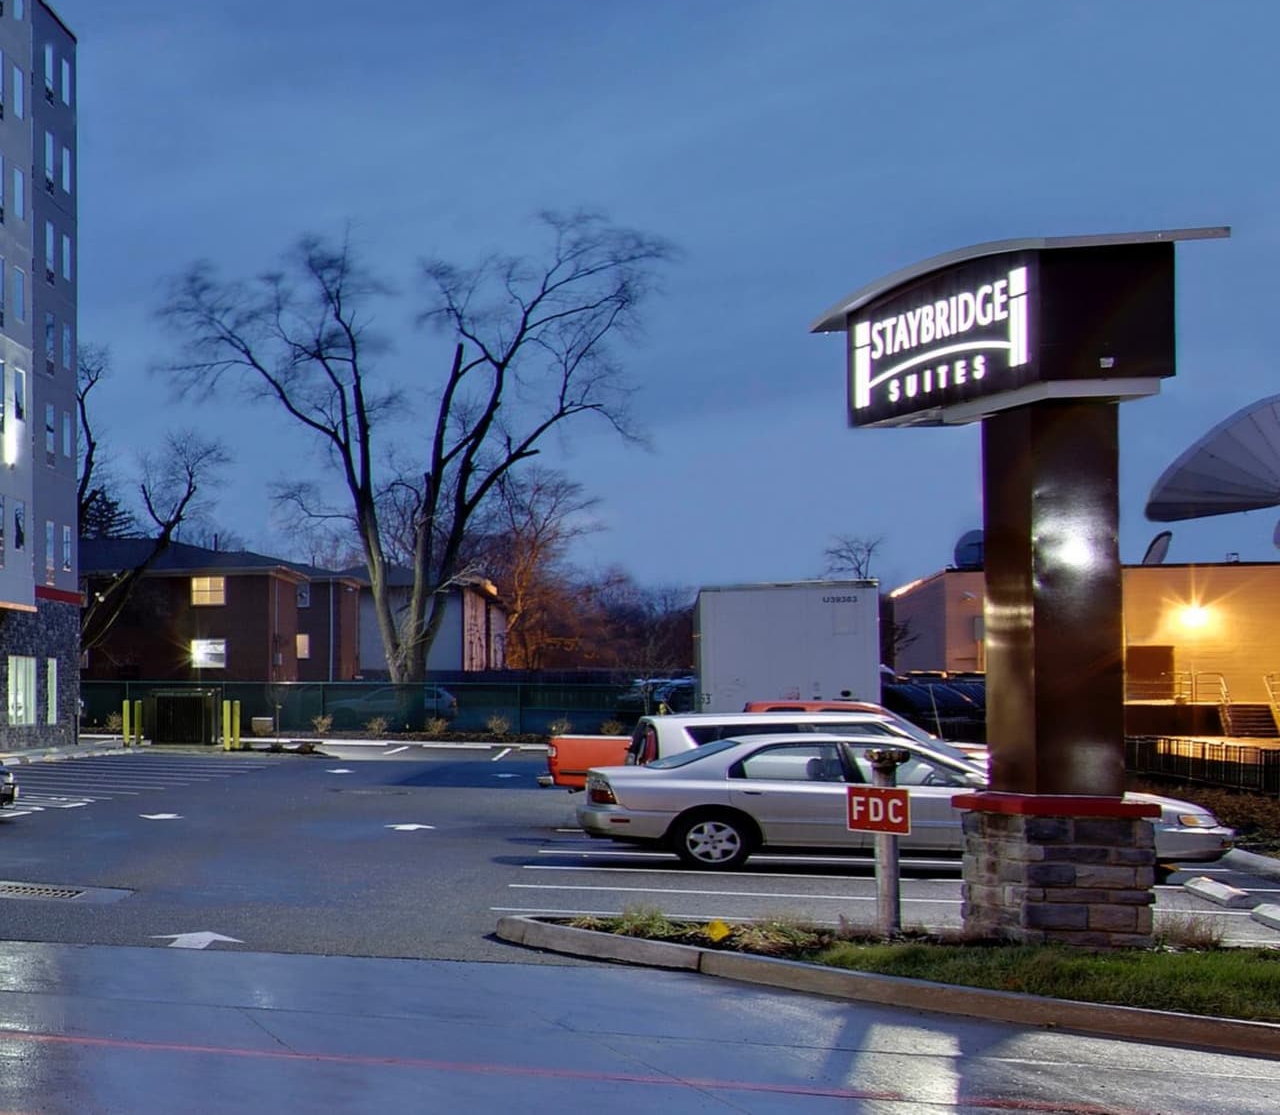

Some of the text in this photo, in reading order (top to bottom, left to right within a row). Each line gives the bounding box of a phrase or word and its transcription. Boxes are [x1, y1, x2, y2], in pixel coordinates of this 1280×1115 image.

[871, 279, 1009, 359] STAYBRIDGE
[888, 355, 987, 403] SUITES
[852, 796, 904, 824] FDC
